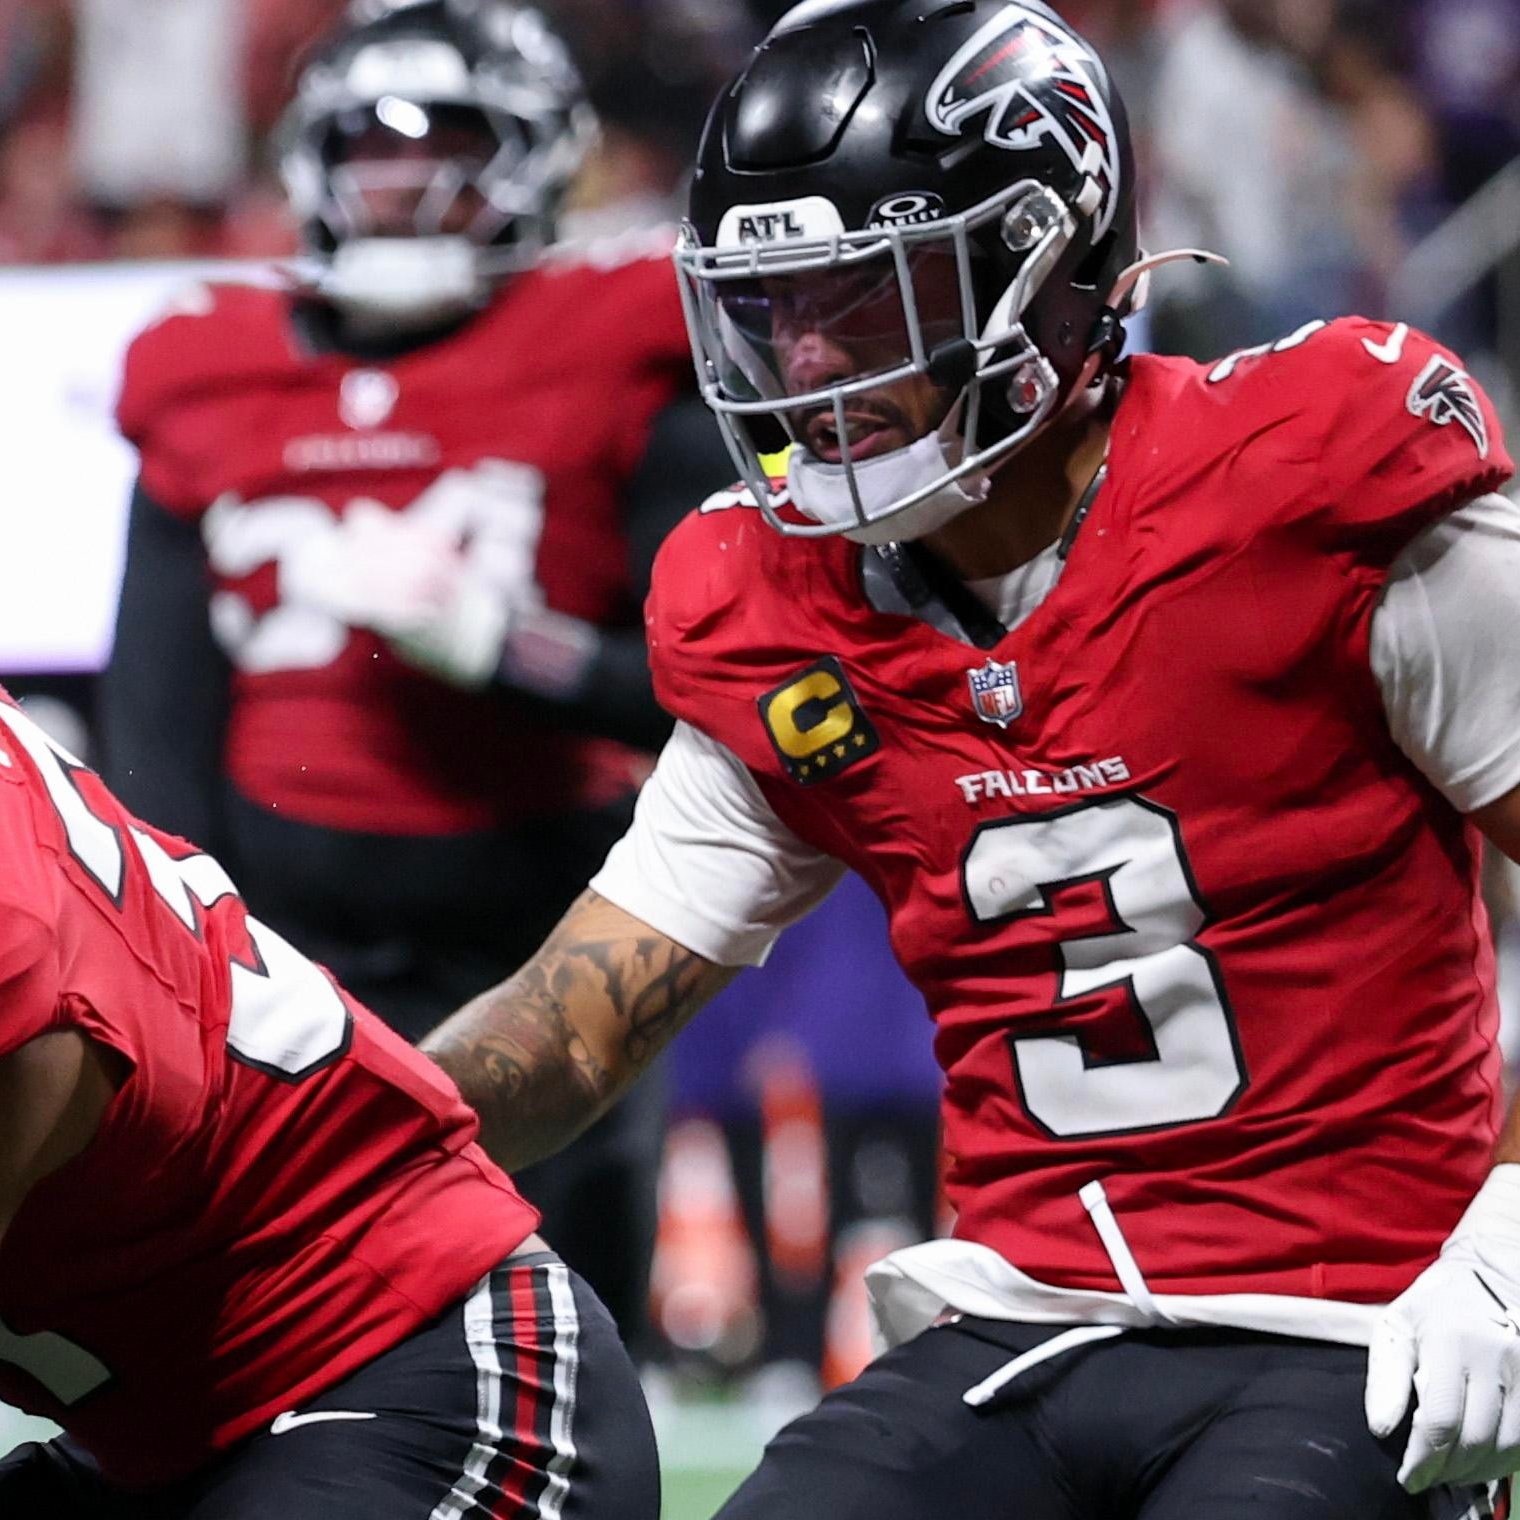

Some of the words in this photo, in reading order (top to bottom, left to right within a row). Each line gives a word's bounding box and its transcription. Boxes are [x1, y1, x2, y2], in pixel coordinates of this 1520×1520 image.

[738, 210, 805, 243] ATL
[767, 670, 854, 759] C
[979, 687, 1015, 716] NFL
[955, 755, 1131, 803] FALCONS
[963, 794, 1249, 1140] 3
